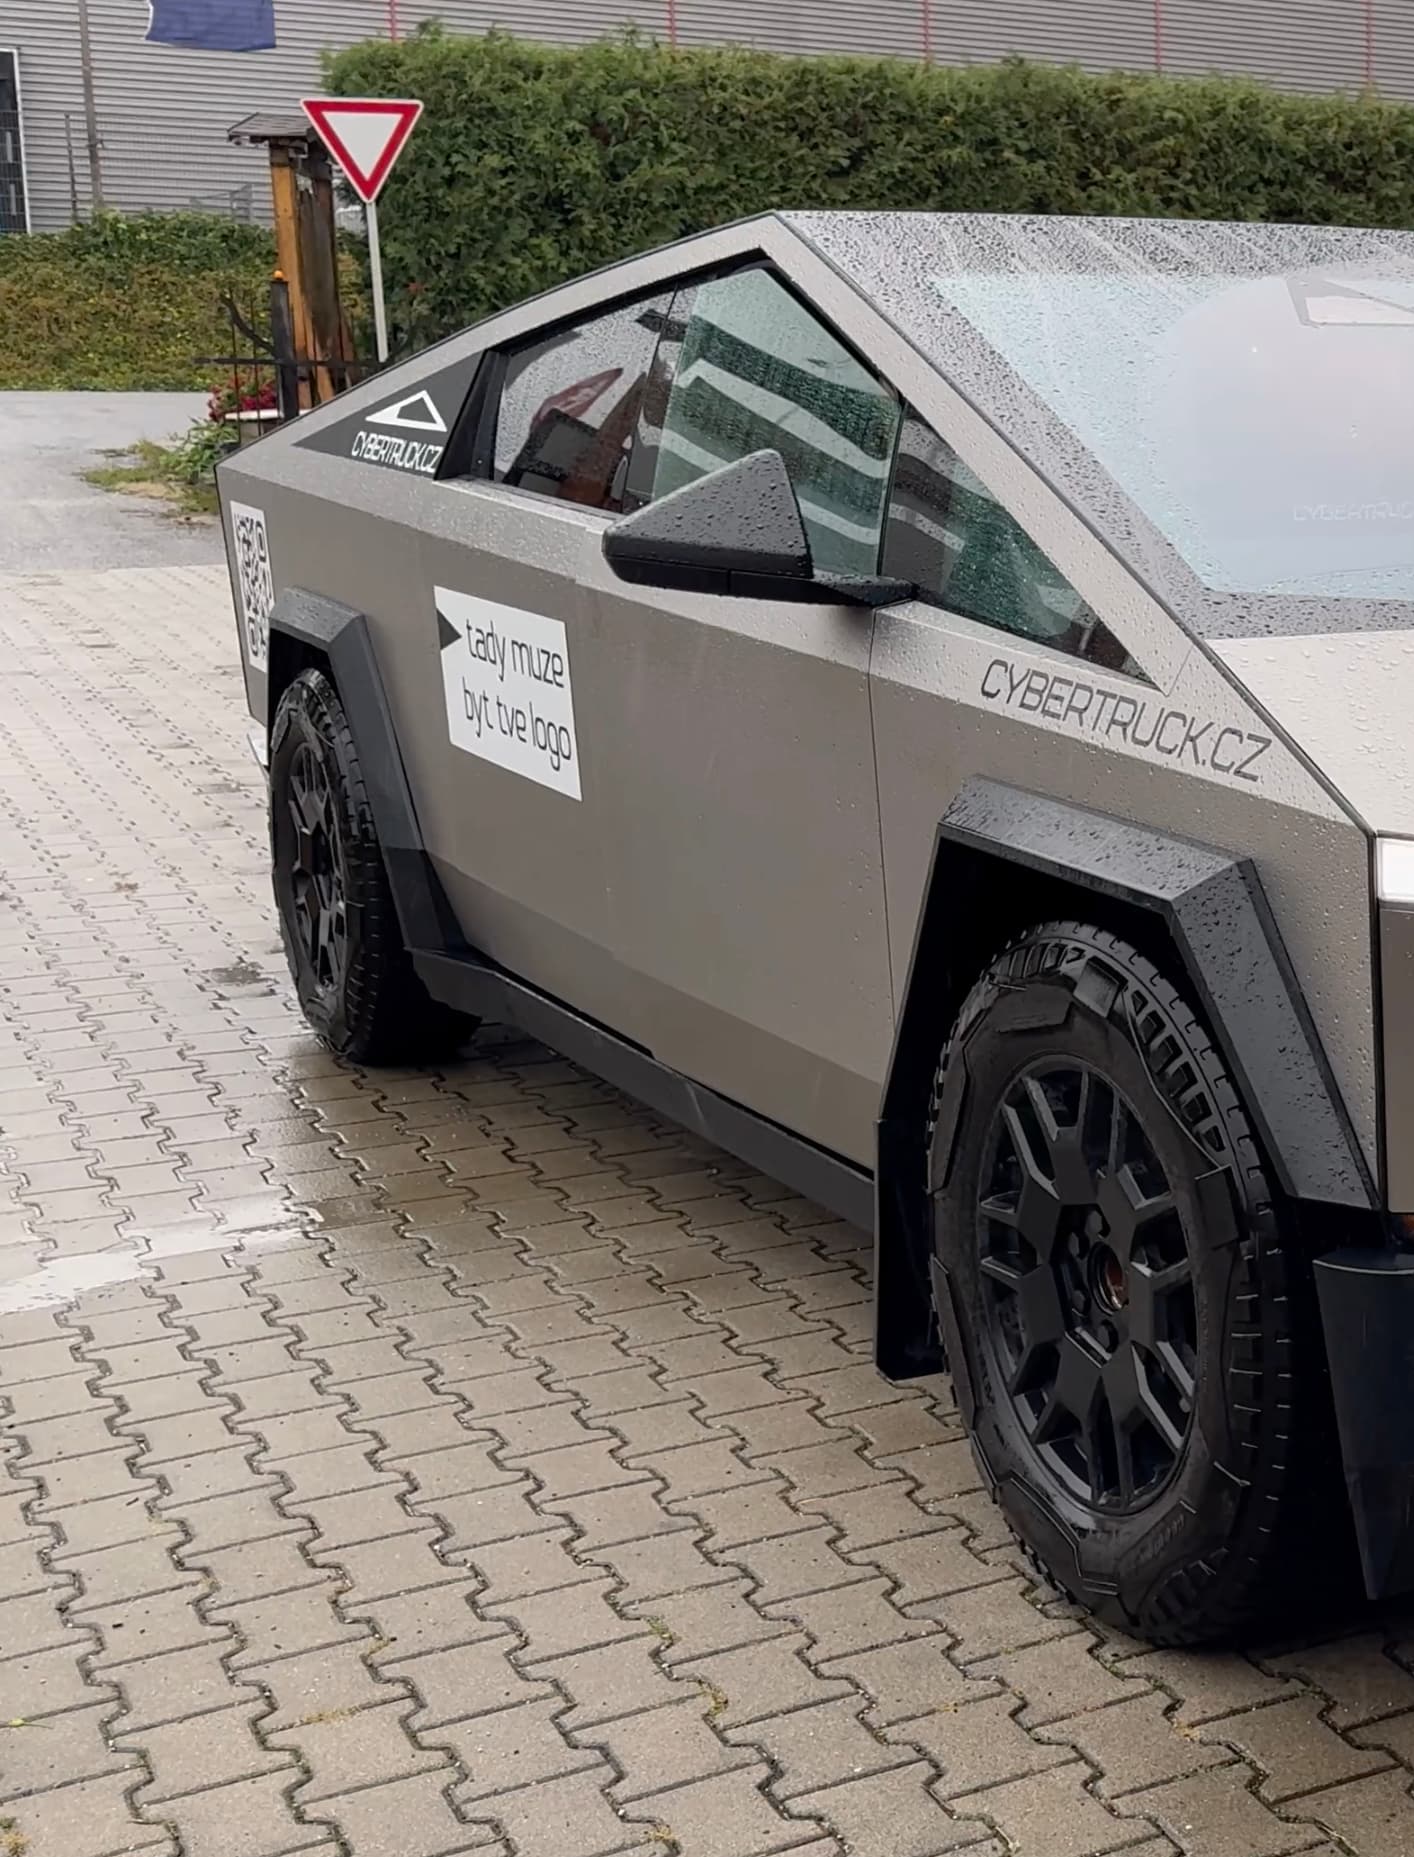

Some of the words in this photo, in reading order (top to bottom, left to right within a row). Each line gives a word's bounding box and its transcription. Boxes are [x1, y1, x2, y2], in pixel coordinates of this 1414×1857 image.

[351, 430, 444, 473] CYBERTRUCK.CZ
[465, 618, 507, 681] tady
[511, 642, 565, 689] muze
[461, 676, 493, 739] byt
[496, 694, 527, 744] tve
[528, 701, 572, 772] logo
[980, 658, 1273, 783] CYBERTRUCK.CZ
